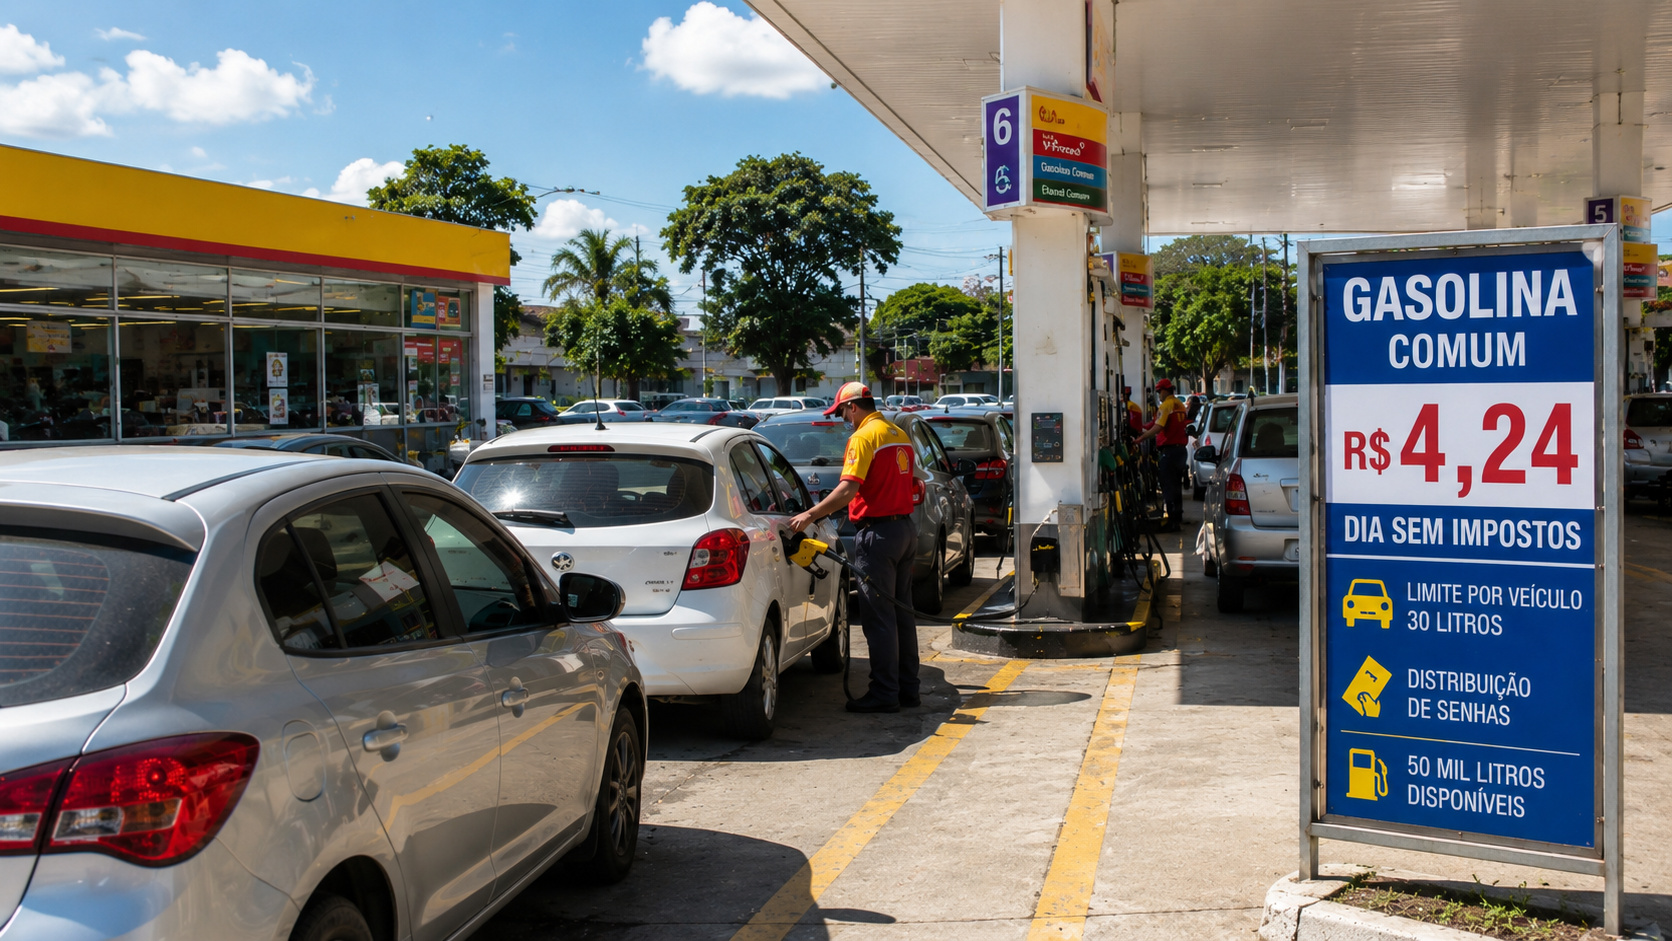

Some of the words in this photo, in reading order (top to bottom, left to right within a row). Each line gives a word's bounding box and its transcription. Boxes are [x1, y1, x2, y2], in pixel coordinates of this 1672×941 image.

[993, 107, 1012, 146] 6
[1595, 205, 1607, 223] 5
[1343, 269, 1578, 322] GASOLINA
[1389, 332, 1526, 369] COMUM
[1344, 428, 1391, 475] R$
[1400, 402, 1578, 498] 4,24
[1344, 515, 1384, 543] DIA
[1392, 516, 1443, 545] SEM
[1453, 518, 1581, 550] IMPOSTOS
[1407, 582, 1462, 603] LIMITE
[1468, 585, 1503, 605] POR
[1508, 584, 1582, 610] VEÍCULO
[1407, 611, 1430, 631] 30
[1436, 612, 1503, 636] LITROS
[1408, 668, 1531, 700] DISTRIBUIÇÃO
[1408, 697, 1431, 719] DE
[1437, 700, 1511, 726] SENHAS
[1408, 755, 1430, 777] 50
[1437, 757, 1470, 782] MIL
[1477, 761, 1545, 789] LITROS
[1408, 784, 1525, 818] DISPONÍVEIS
